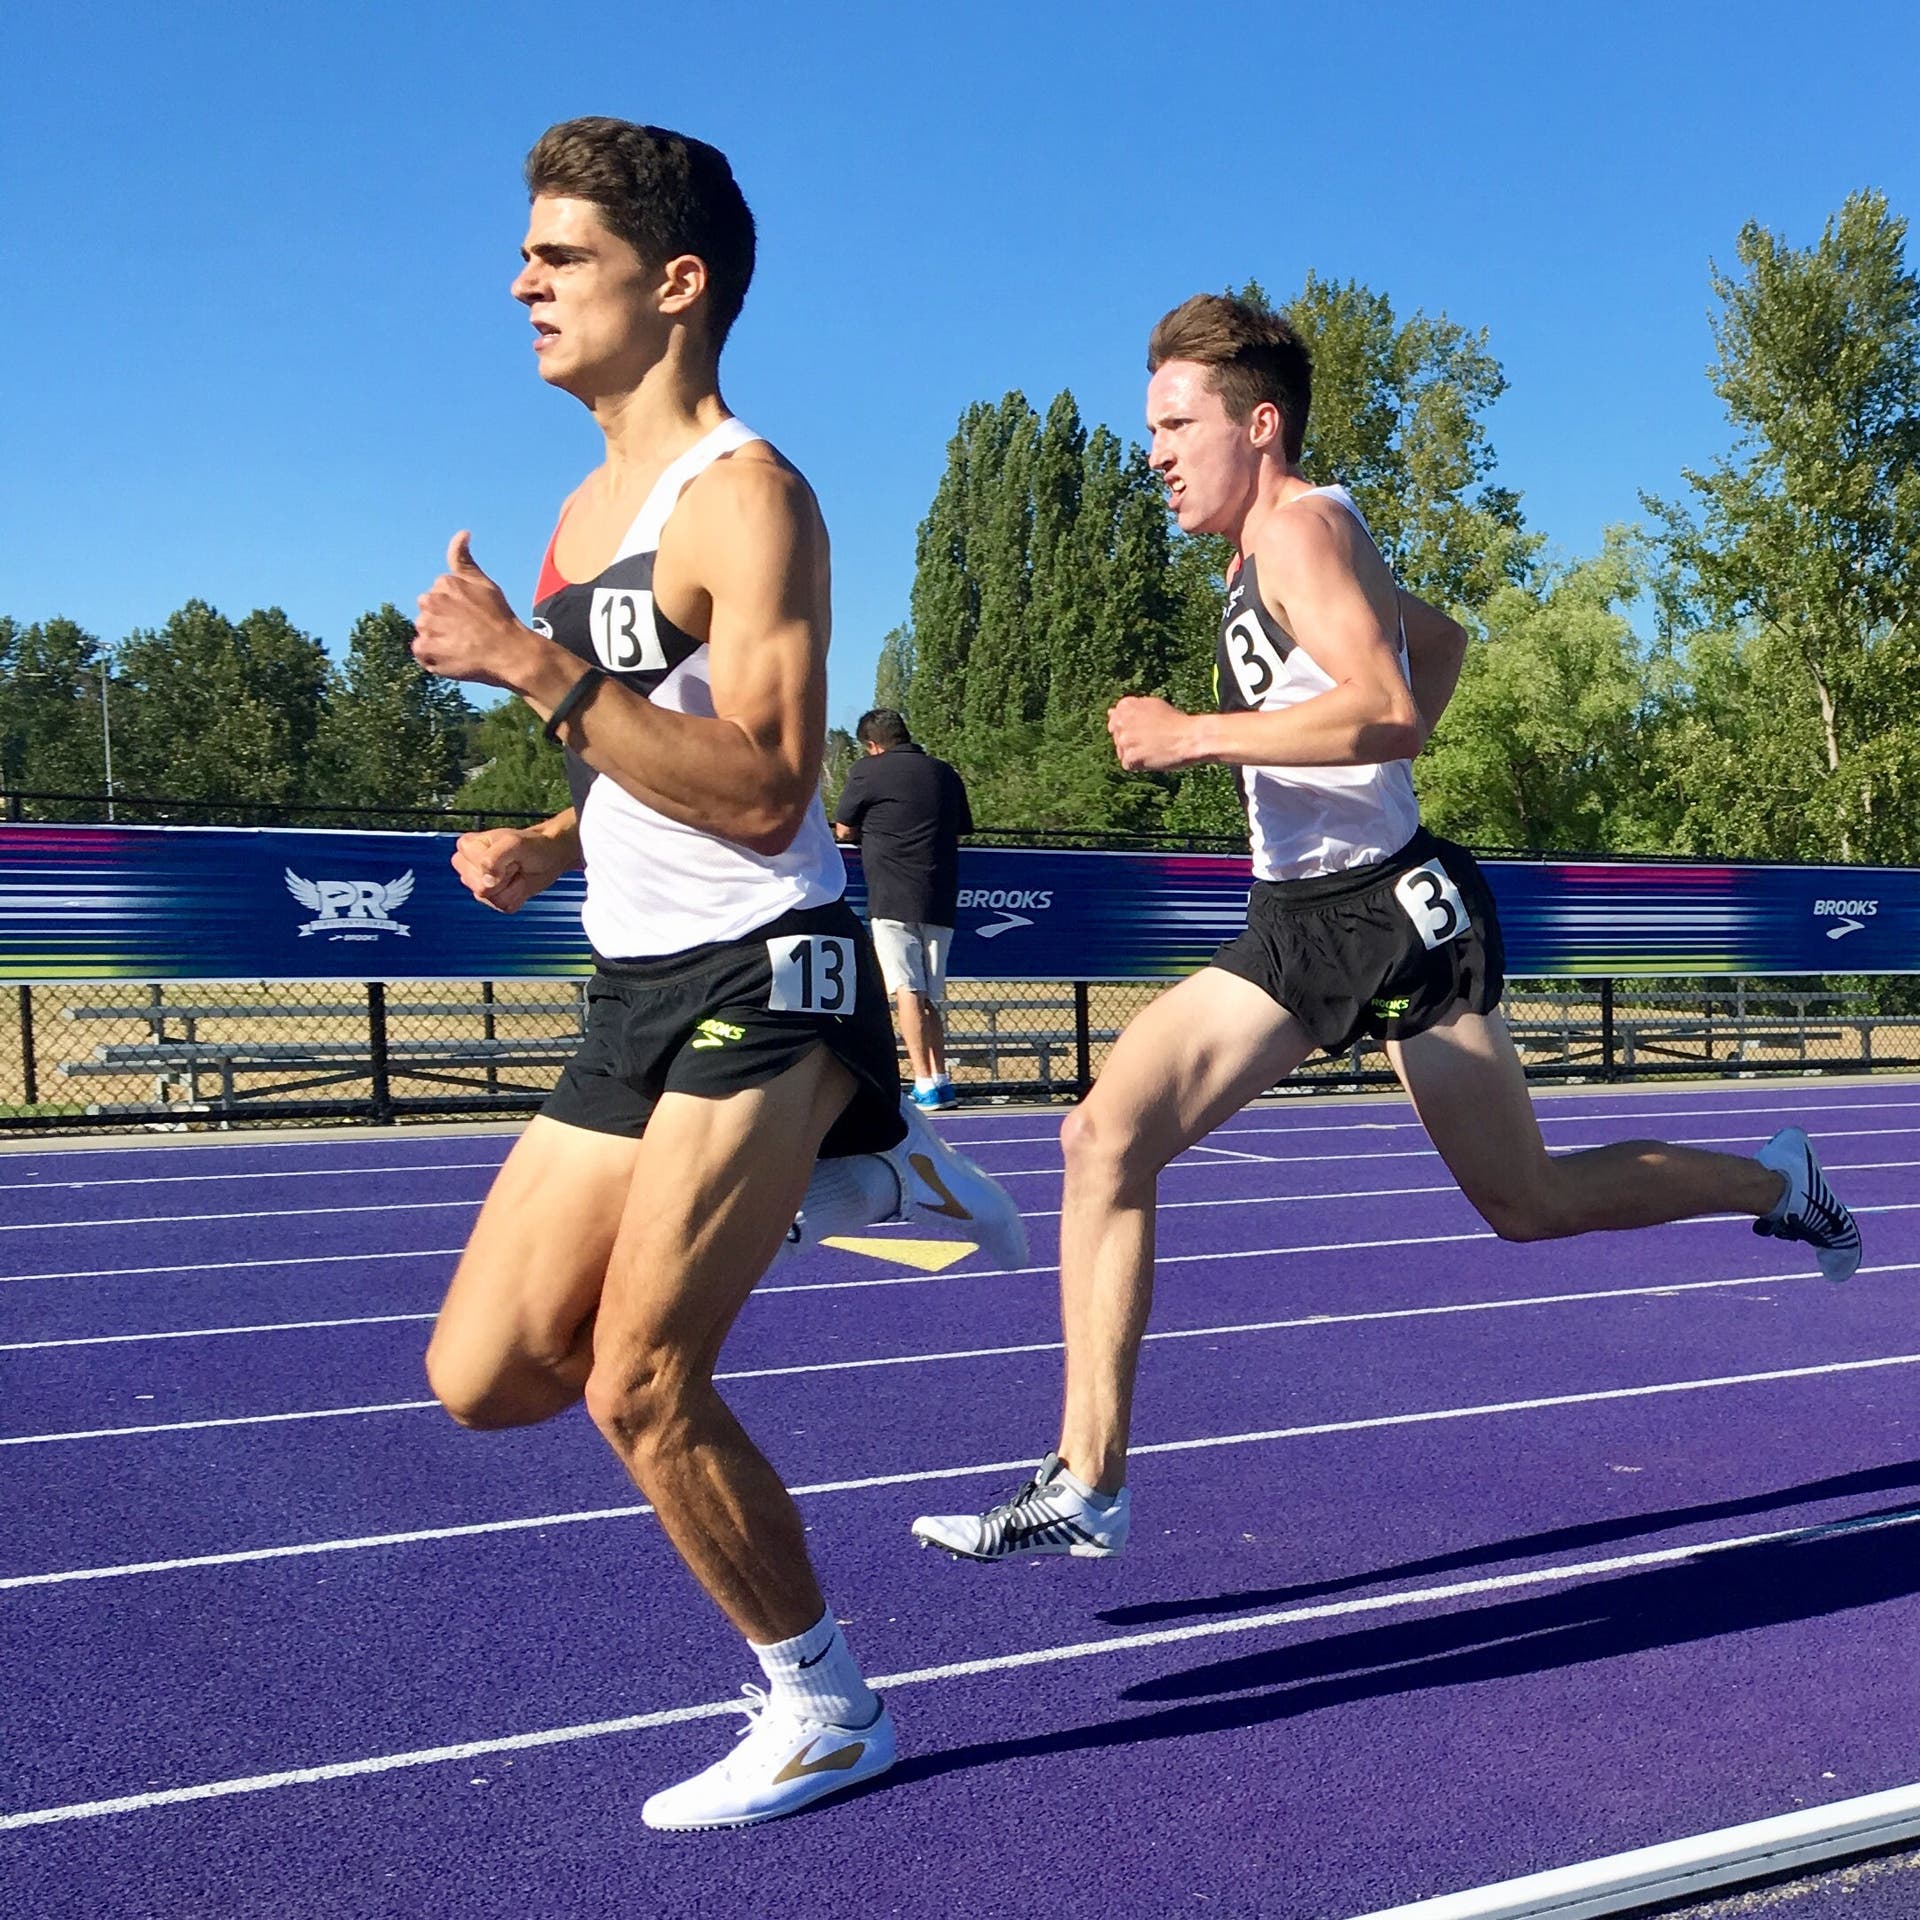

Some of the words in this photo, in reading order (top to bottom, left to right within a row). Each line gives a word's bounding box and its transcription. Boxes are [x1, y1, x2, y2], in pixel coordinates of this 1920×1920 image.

[601, 595, 642, 668] 13
[1231, 624, 1273, 695] 3
[316, 880, 389, 919] PR
[956, 889, 1054, 909] BROOKS
[1407, 871, 1457, 940] 3
[1813, 900, 1879, 915] BROOKS
[789, 940, 844, 1010] 13
